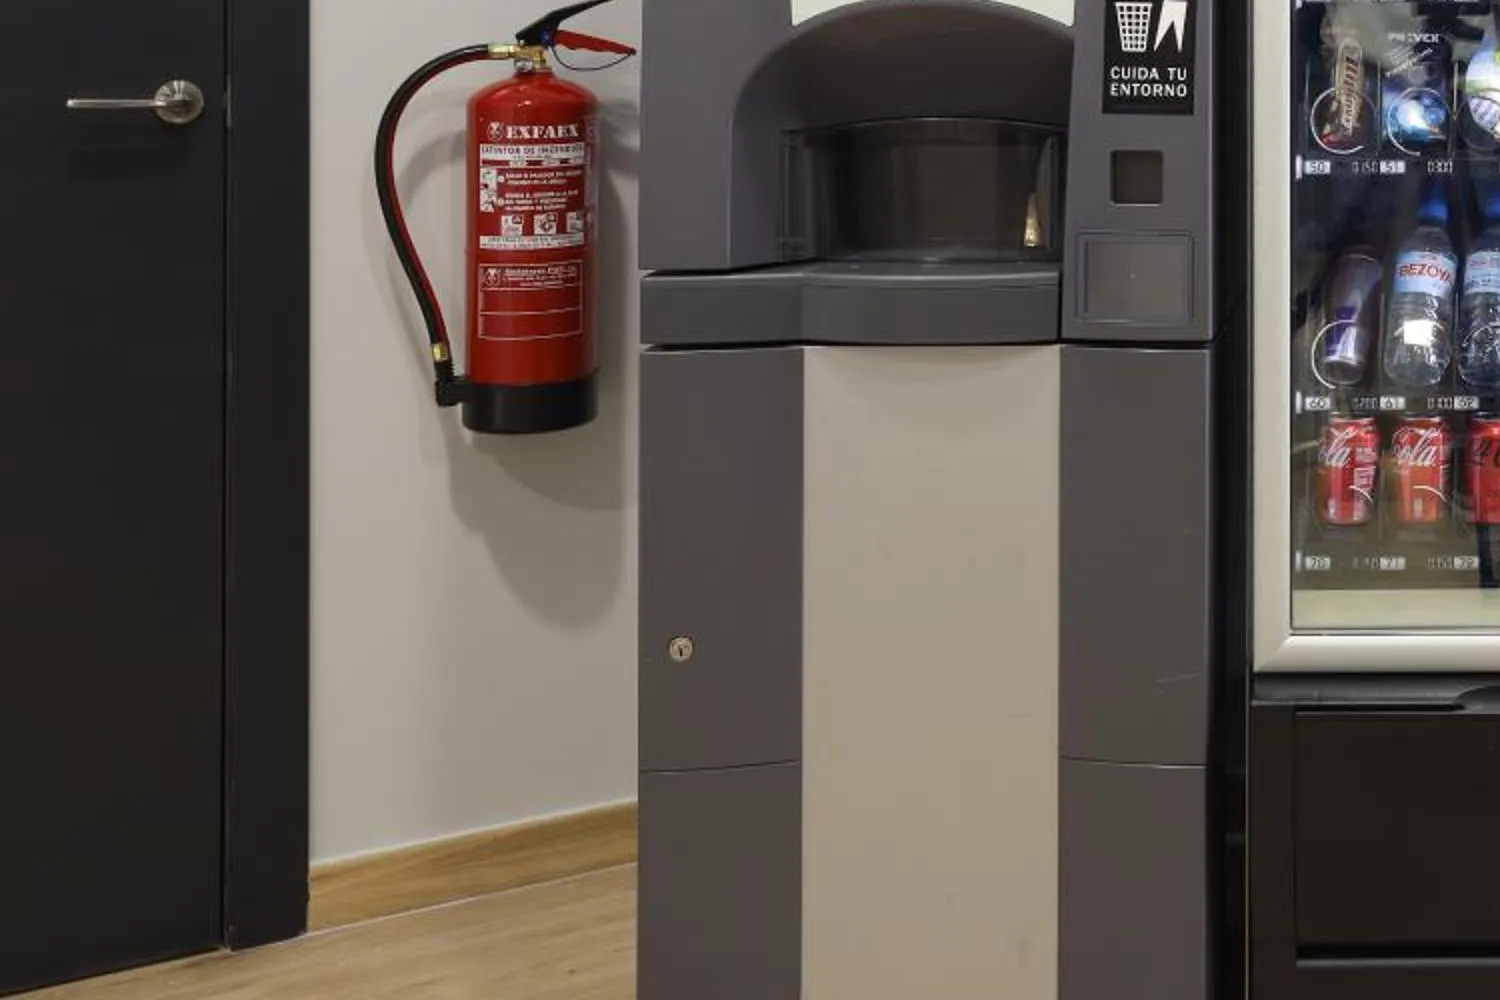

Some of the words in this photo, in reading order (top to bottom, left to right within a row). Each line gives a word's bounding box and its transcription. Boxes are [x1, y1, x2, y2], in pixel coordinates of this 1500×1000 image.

[1110, 65, 1160, 80] CUIDA
[1167, 66, 1187, 81] TU
[1110, 82, 1188, 98] ENTORNO
[506, 123, 580, 140] EXFAEX
